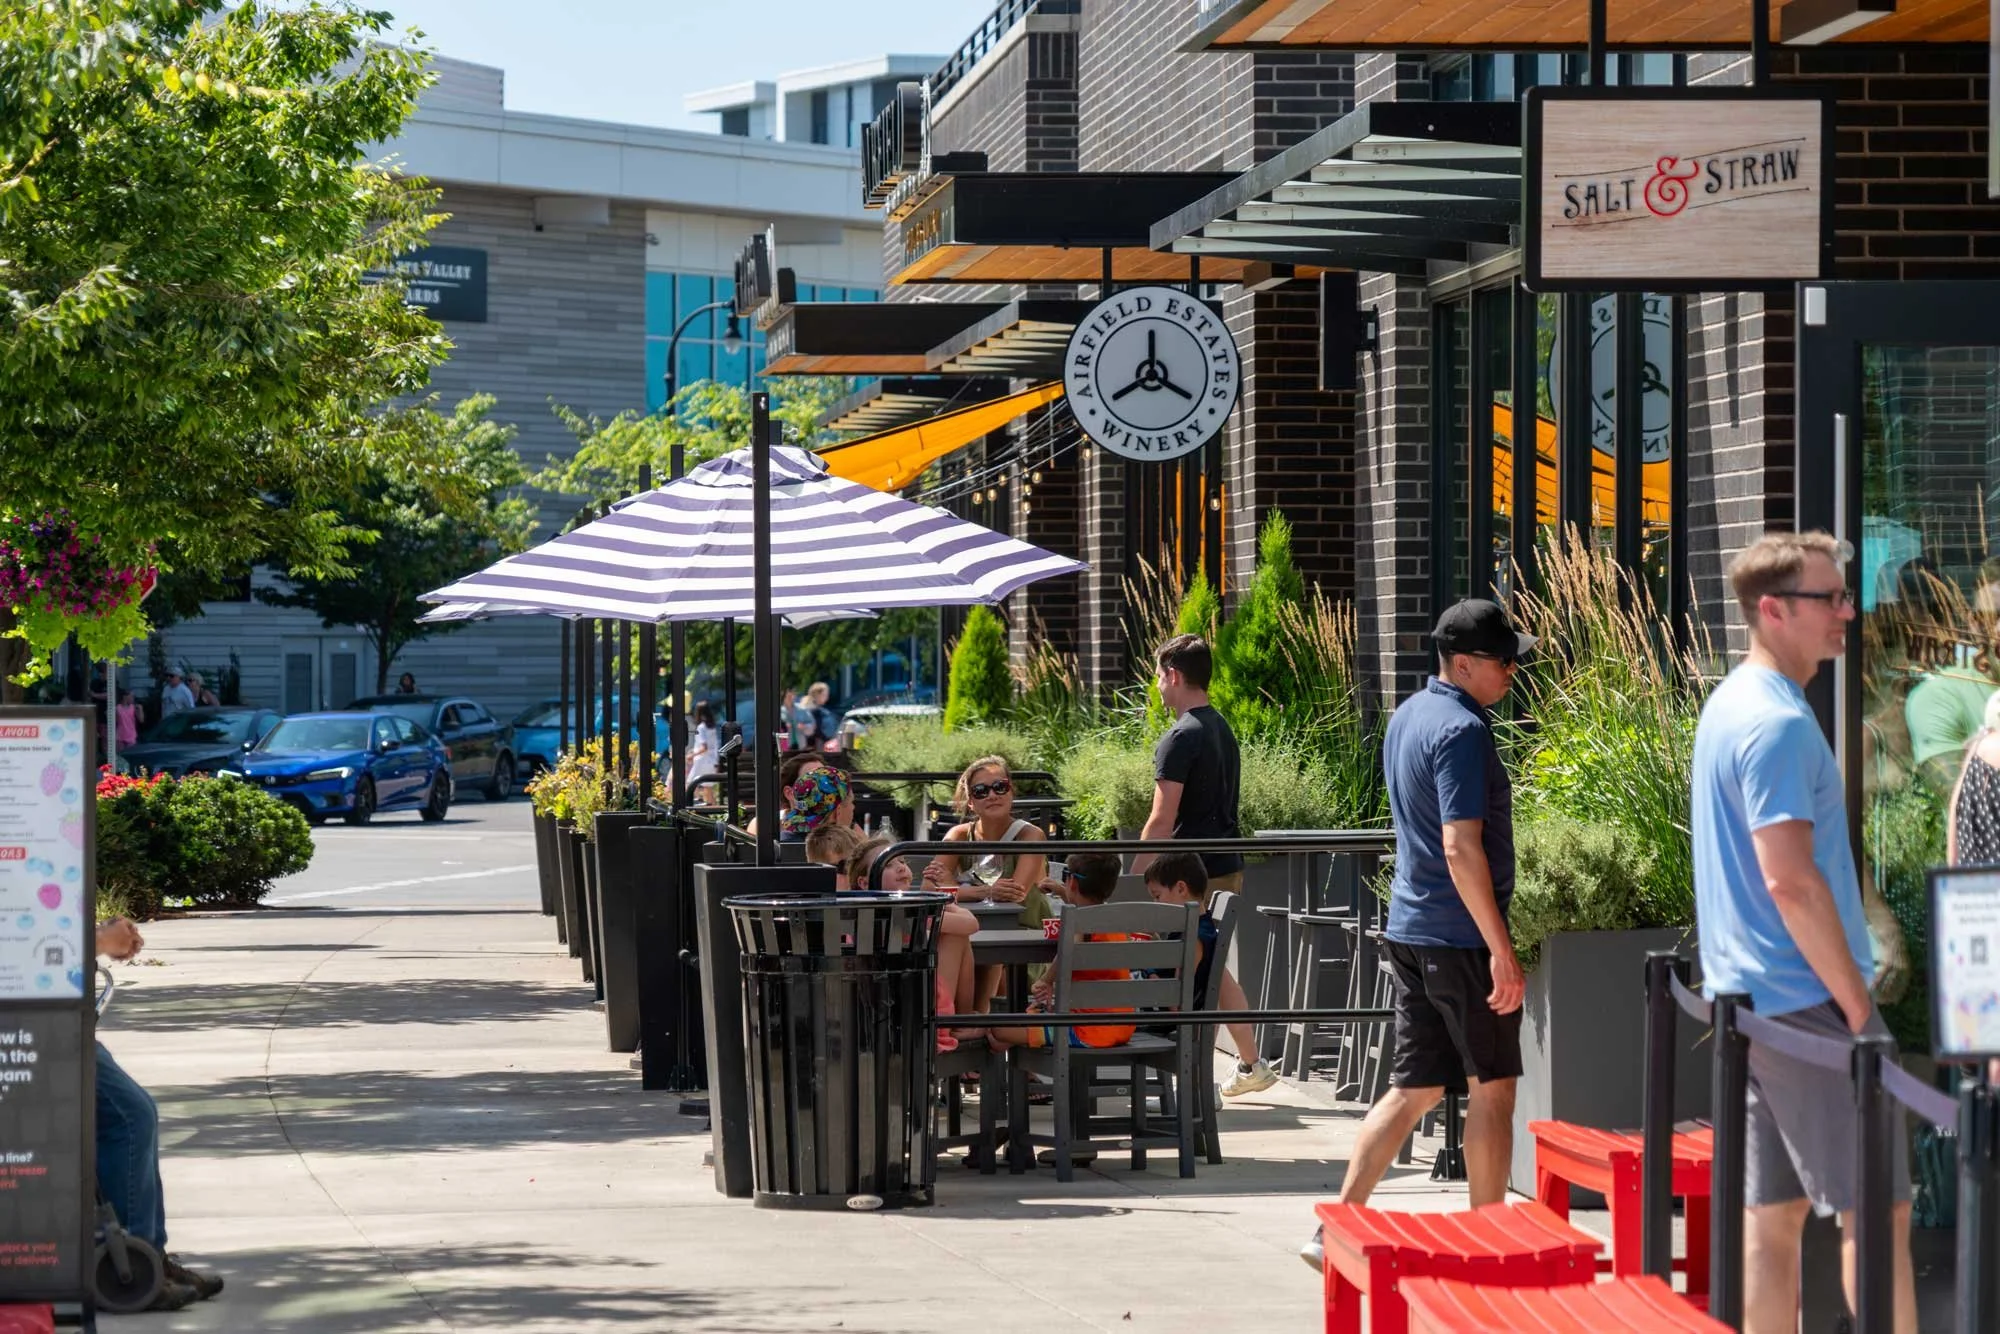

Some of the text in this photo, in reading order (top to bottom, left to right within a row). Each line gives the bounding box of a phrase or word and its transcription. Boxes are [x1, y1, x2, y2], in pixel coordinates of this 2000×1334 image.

[1564, 149, 1799, 218] SALT & STRAW
[405, 288, 440, 304] ARDS
[1074, 296, 1230, 400] AIRFIELD ESTATES
[1102, 419, 1204, 452] WINERY
[0, 727, 37, 737] LAVORS
[19, 1029, 33, 1045] is
[10, 1049, 38, 1063] the
[6, 1151, 33, 1163] line?
